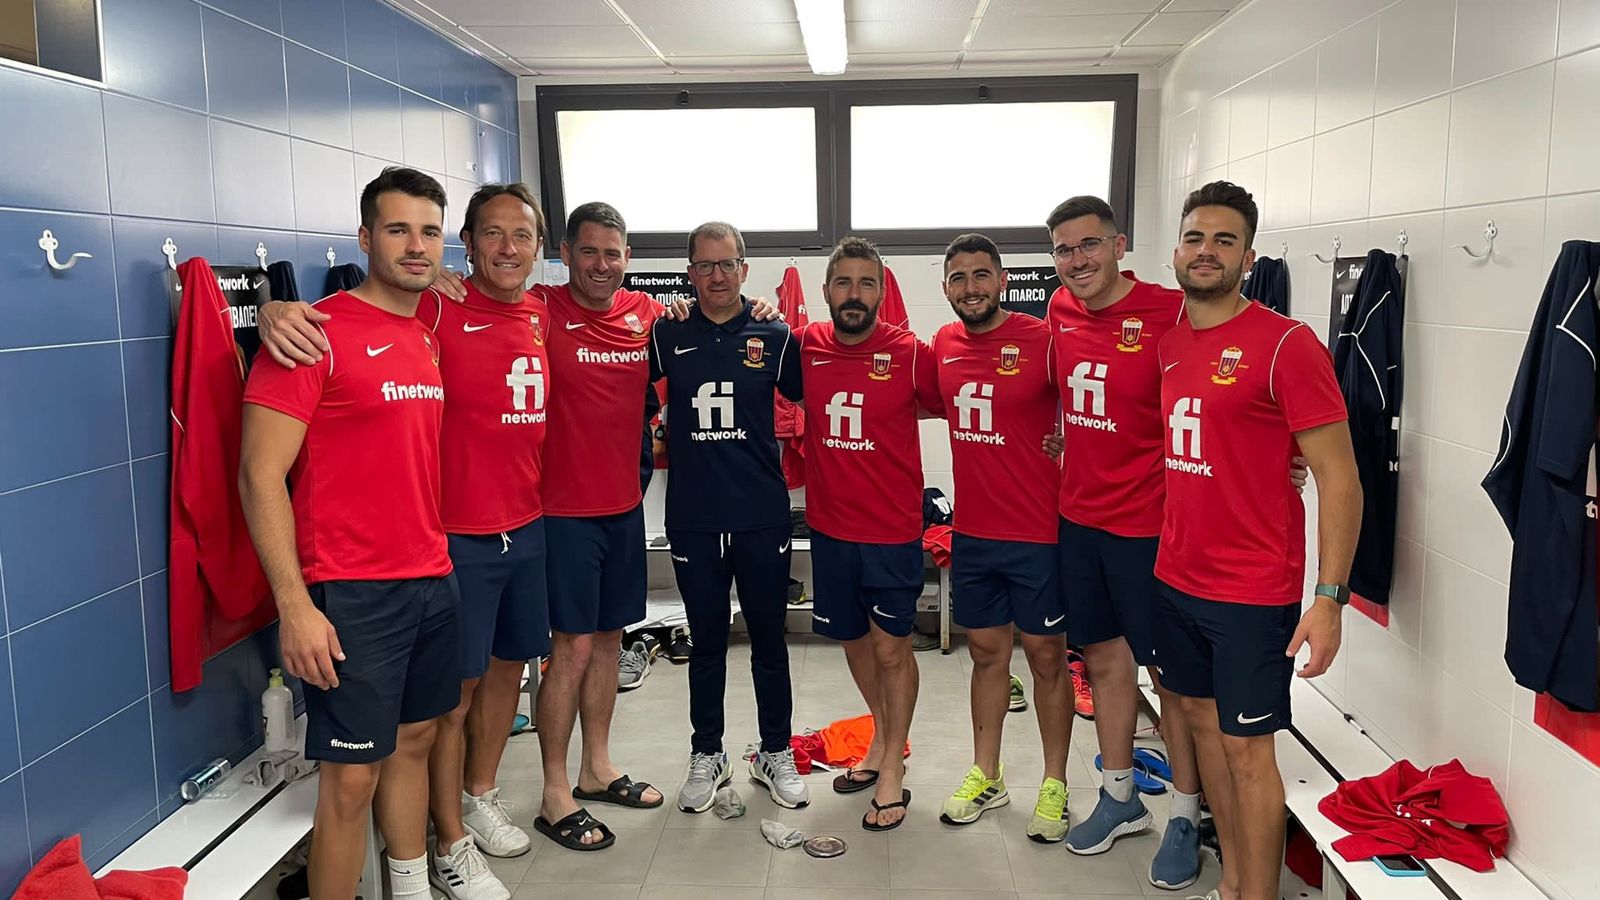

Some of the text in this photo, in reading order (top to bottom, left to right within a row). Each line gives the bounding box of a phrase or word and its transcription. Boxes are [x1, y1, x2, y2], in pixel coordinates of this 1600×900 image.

[217, 273, 250, 291] twork
[630, 276, 683, 286] finetwork
[1007, 271, 1040, 281] twork
[1009, 288, 1046, 302] MARCO
[505, 356, 545, 411] fi
[1067, 361, 1109, 417] fi
[691, 382, 734, 429] fi
[825, 391, 864, 440] fi
[953, 382, 994, 432] fi
[1065, 413, 1118, 433] network
[1168, 397, 1202, 460] fi
[691, 428, 748, 441] network
[953, 430, 1006, 446] network
[1165, 457, 1214, 477] network
[330, 738, 375, 750] finetwork
